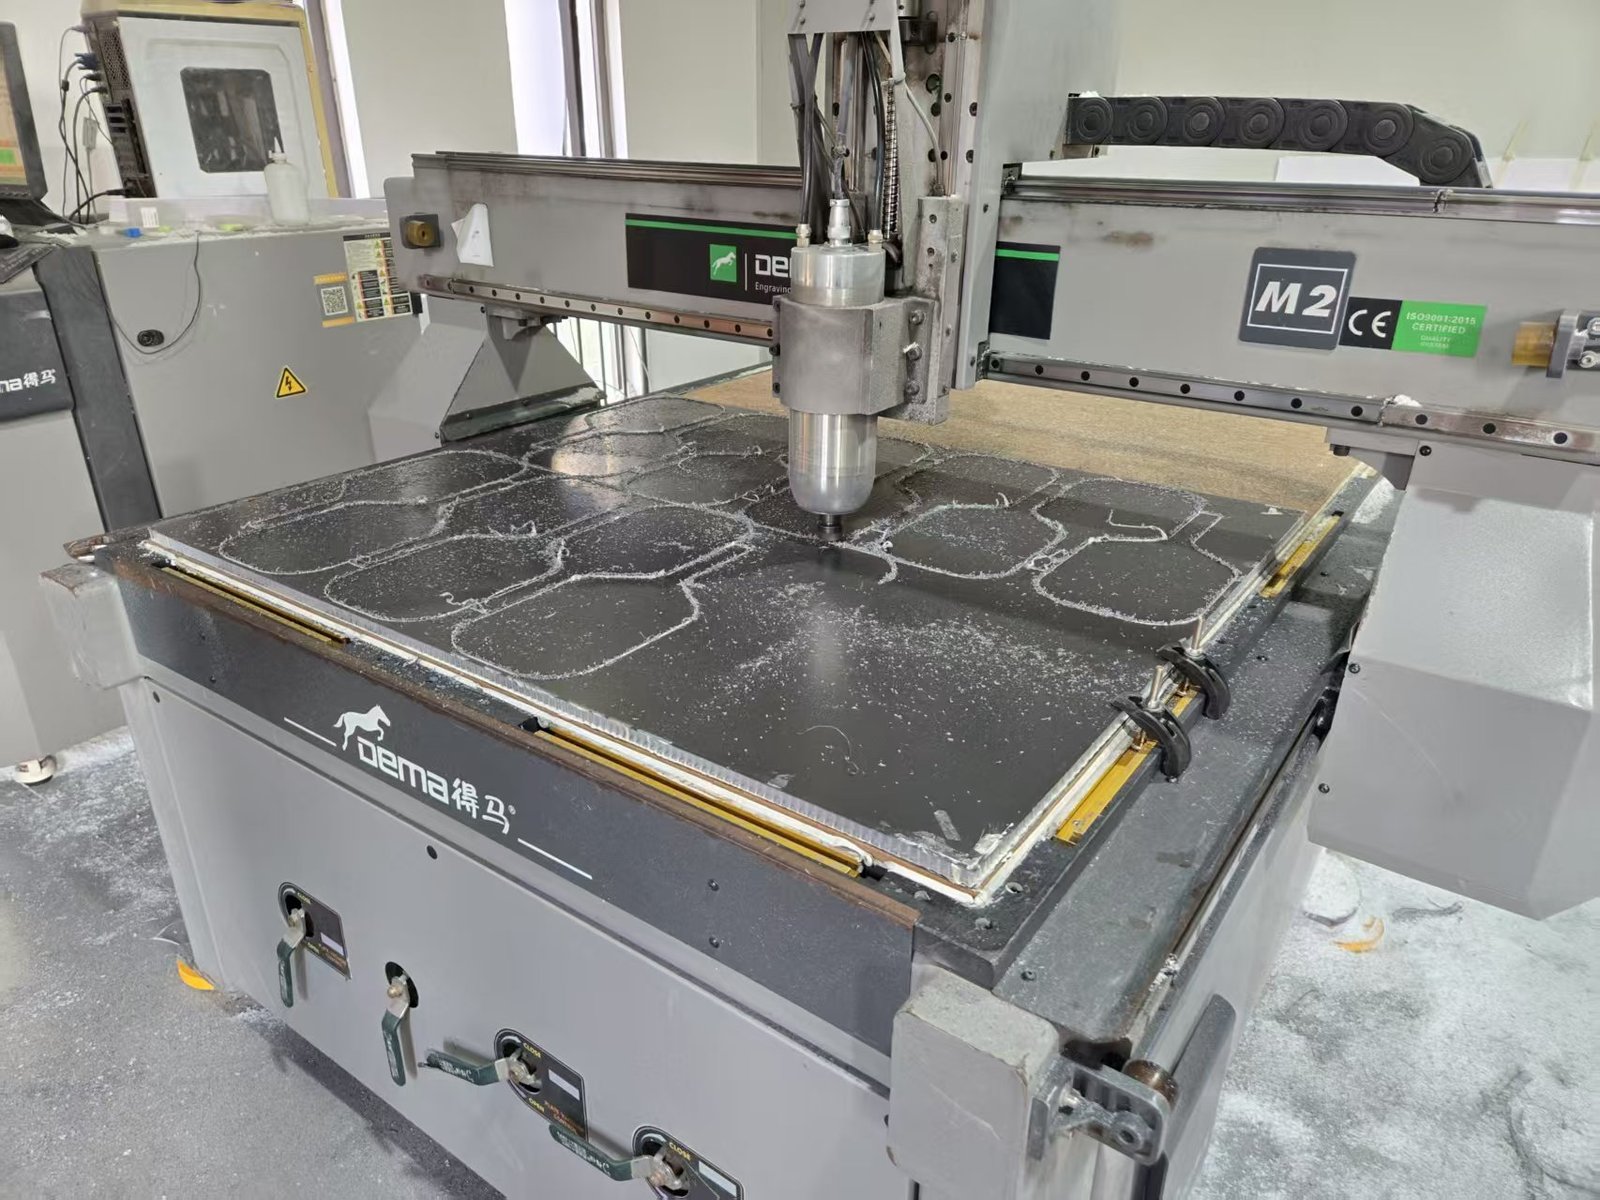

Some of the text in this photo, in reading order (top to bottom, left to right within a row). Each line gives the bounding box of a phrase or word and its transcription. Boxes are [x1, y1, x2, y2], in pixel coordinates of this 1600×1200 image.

[755, 254, 792, 278] De
[1348, 309, 1392, 338] CE
[1406, 311, 1477, 325] ISO9001:2015
[1411, 322, 1466, 335] CERTIFIED
[523, 1042, 541, 1058] CLOSE
[528, 1097, 545, 1112] OPEN
[669, 1142, 691, 1160] CLOSE
